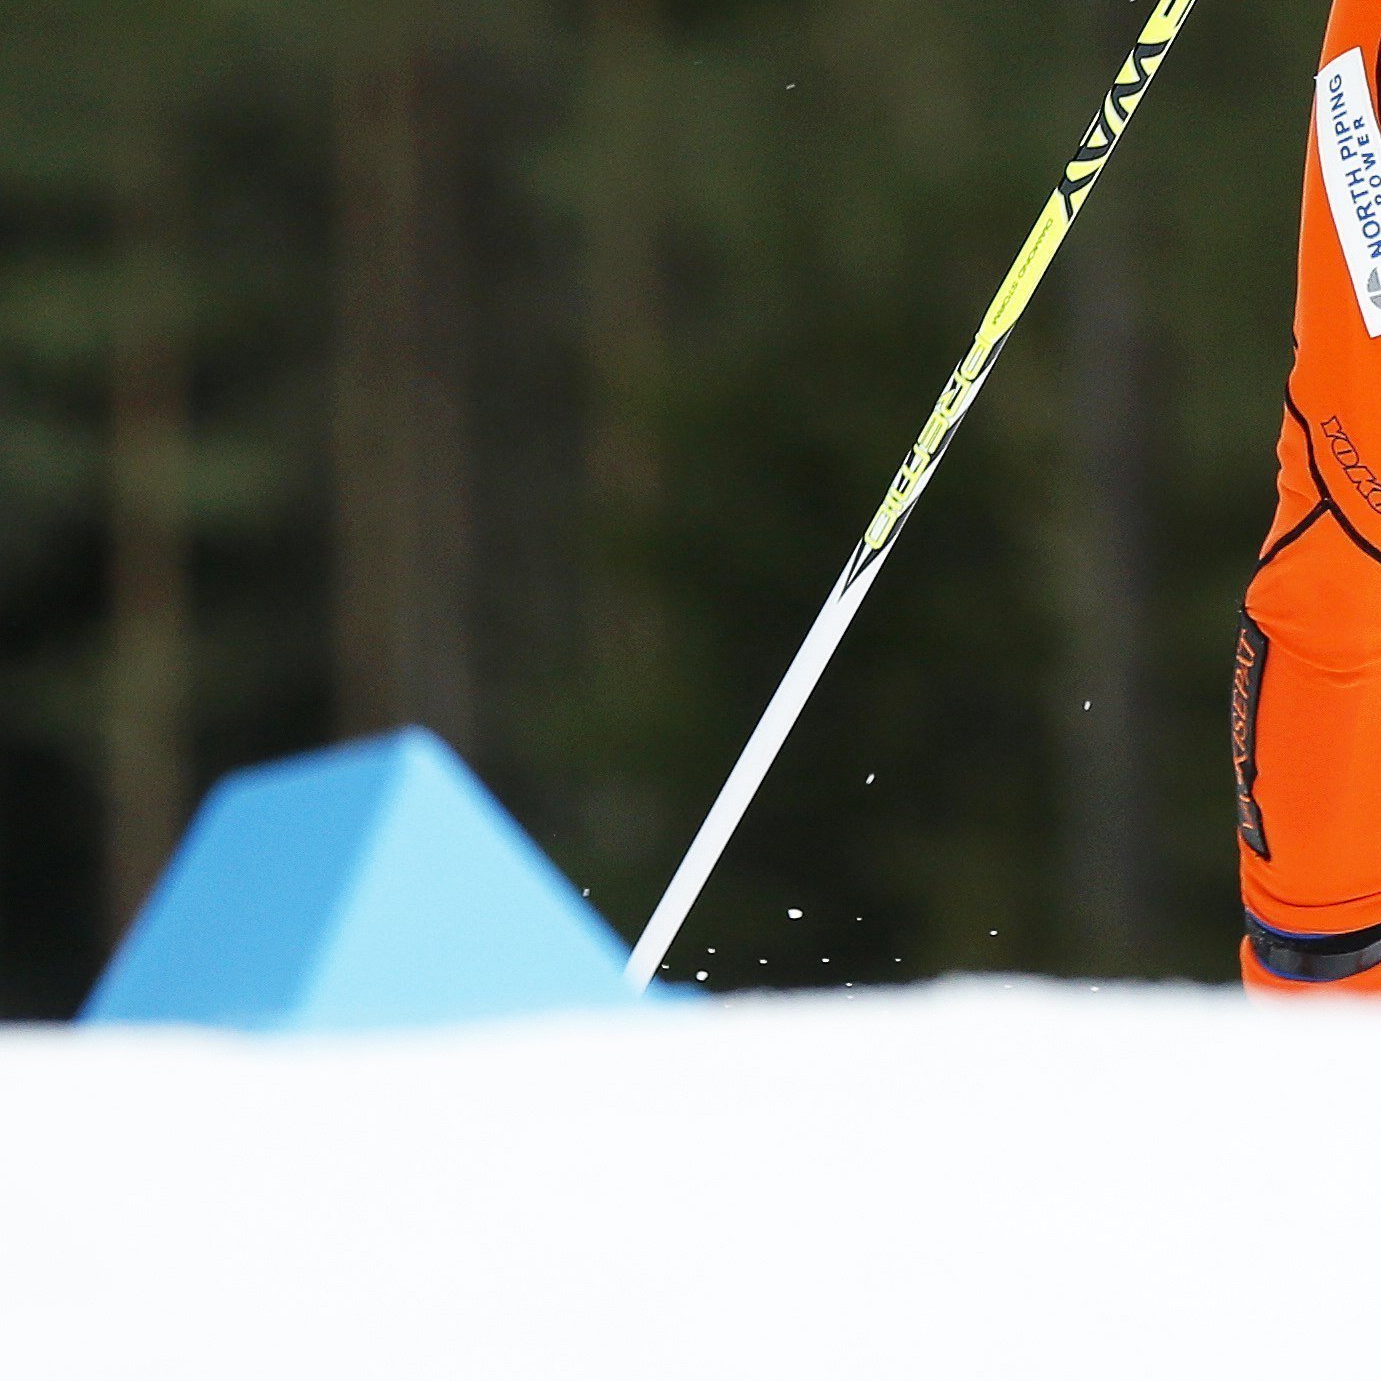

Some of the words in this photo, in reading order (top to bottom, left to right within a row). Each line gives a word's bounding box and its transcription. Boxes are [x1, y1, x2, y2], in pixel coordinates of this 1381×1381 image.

[1060, 39, 1173, 221] WAY
[1329, 73, 1358, 162] PIPING
[1018, 218, 1054, 279] DIAMOND
[992, 280, 1020, 326] STORM
[864, 332, 992, 550] PREMIO
